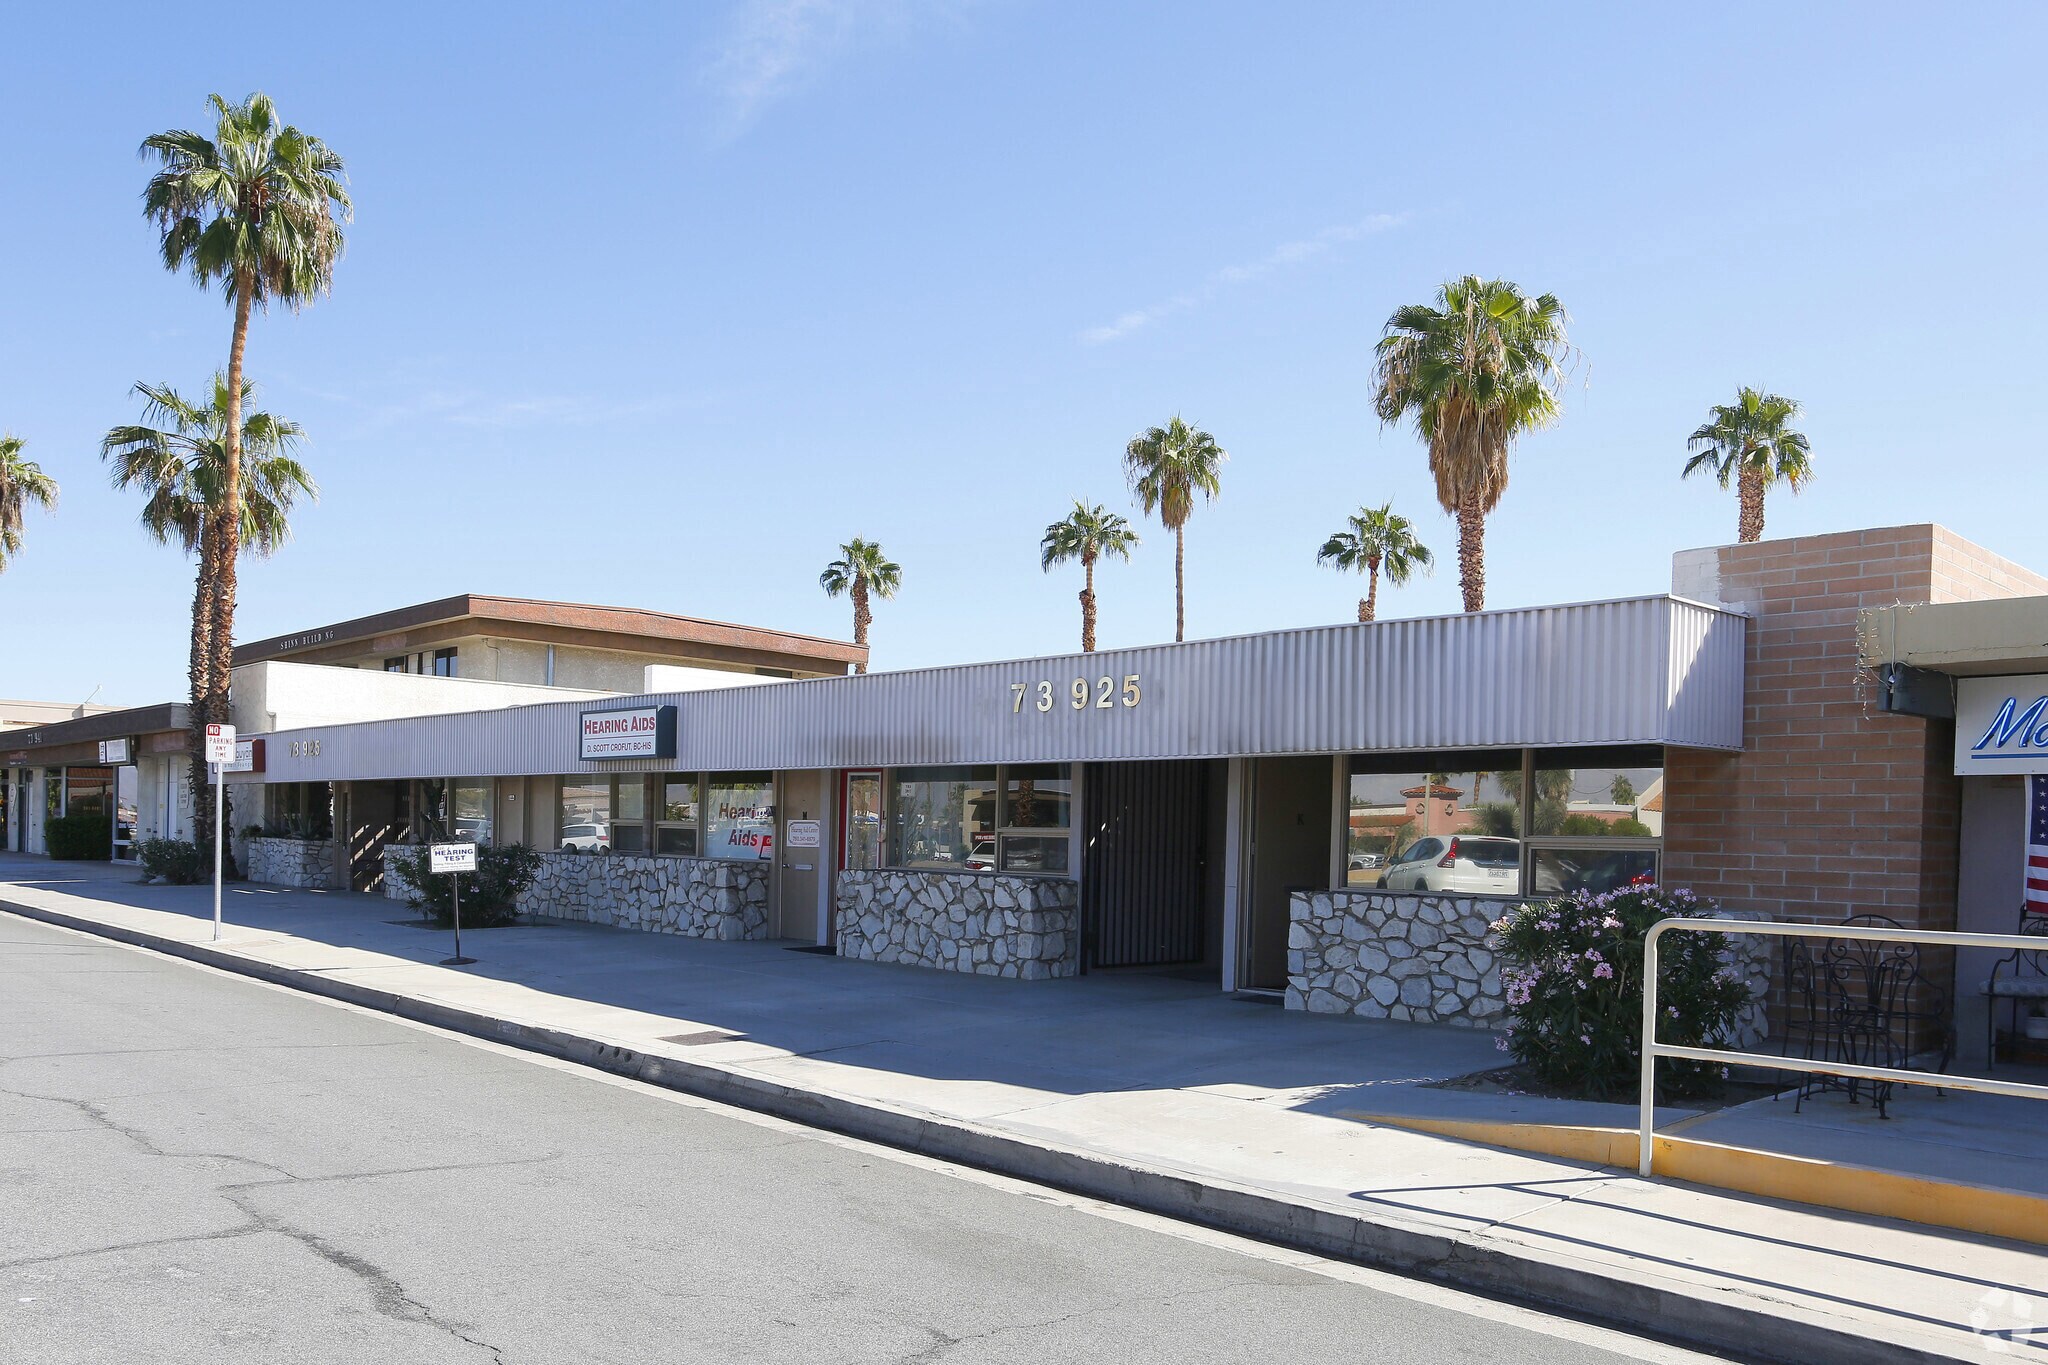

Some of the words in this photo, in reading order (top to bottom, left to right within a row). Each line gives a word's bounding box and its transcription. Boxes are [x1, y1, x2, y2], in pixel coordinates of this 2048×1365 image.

[302, 633, 322, 645] BUILD
[1011, 680, 1053, 712] 73
[1071, 674, 1141, 710] 925
[208, 725, 219, 735] NO
[584, 718, 628, 735] HEARING
[630, 715, 656, 732] AIDS
[208, 737, 233, 746] PARKING
[289, 741, 300, 757] 73
[302, 740, 320, 757] 925
[593, 743, 610, 753] SCOTT
[610, 742, 633, 752] CROFUT,
[633, 741, 652, 751] BC-HIS
[727, 829, 758, 847] Aids
